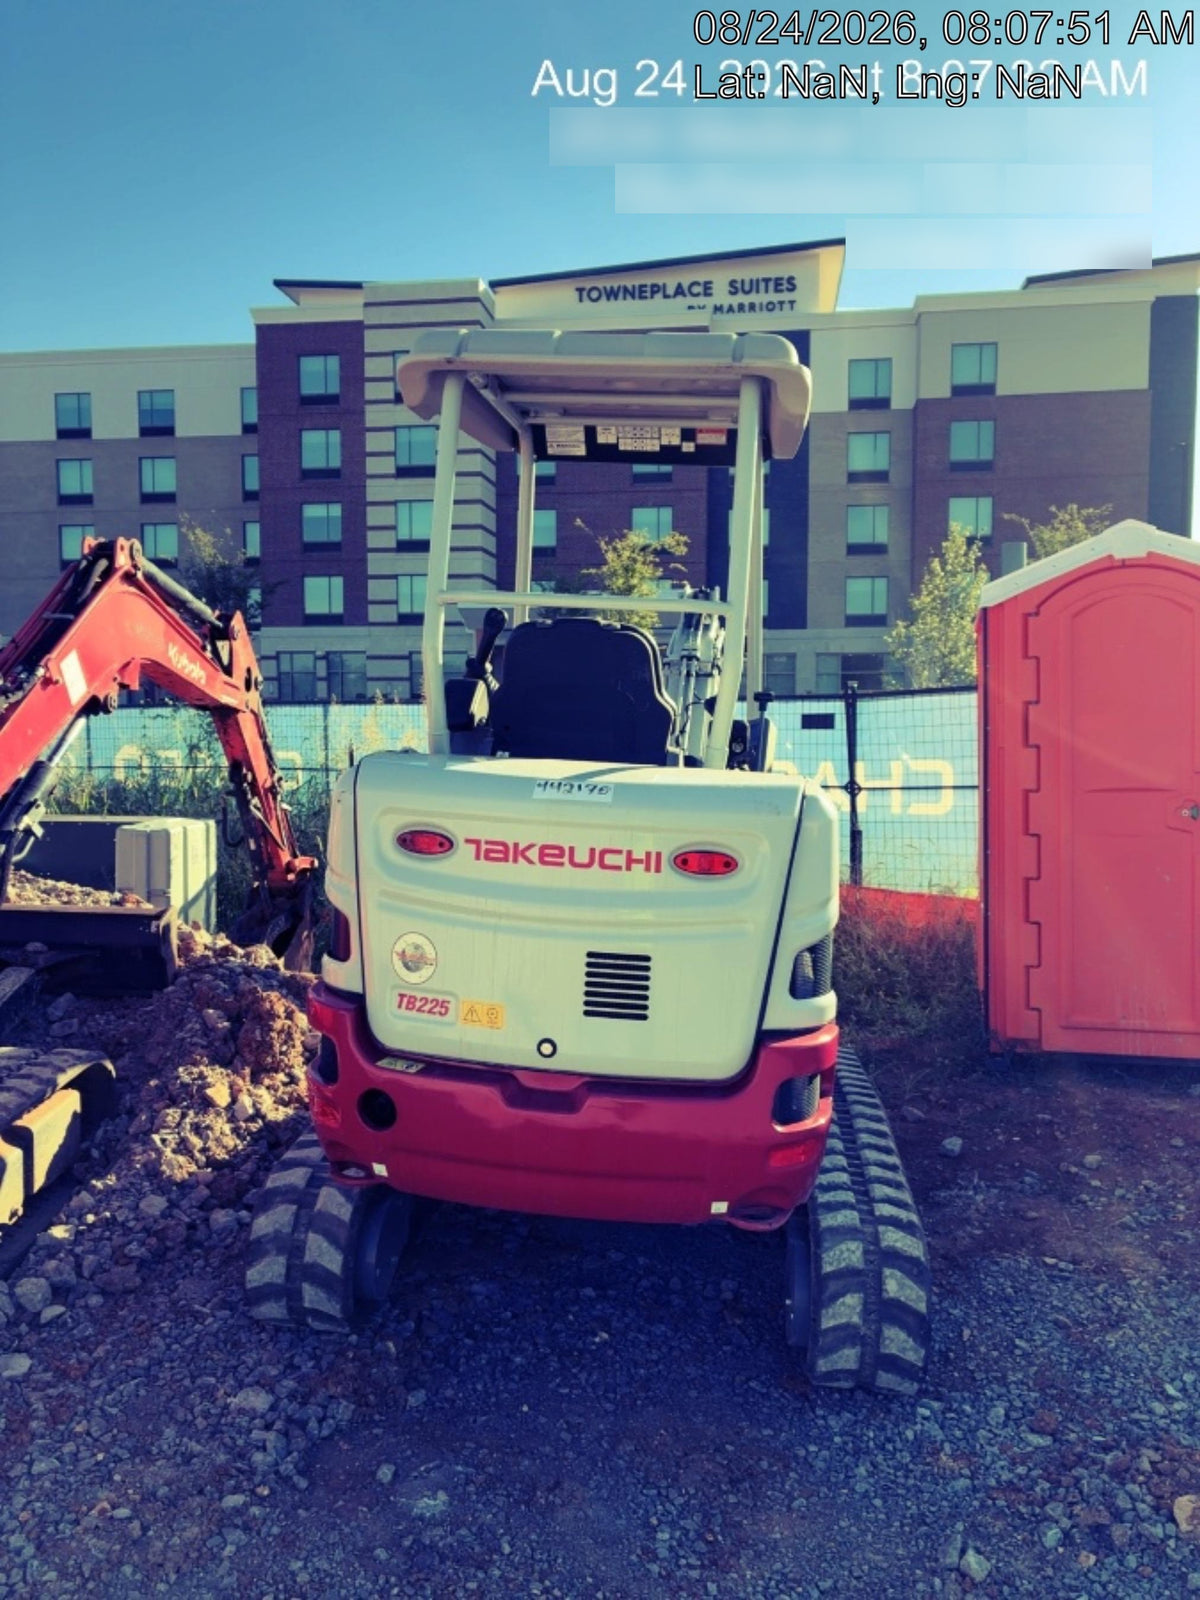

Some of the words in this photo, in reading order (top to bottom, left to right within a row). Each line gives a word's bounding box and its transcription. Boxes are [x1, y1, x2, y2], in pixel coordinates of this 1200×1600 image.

[575, 280, 714, 303] TOWNEPLACE
[728, 275, 797, 296] SUITES
[712, 300, 798, 315] MARRIOTT
[464, 838, 663, 873] TAKEUCHI
[397, 992, 451, 1017] TB225
